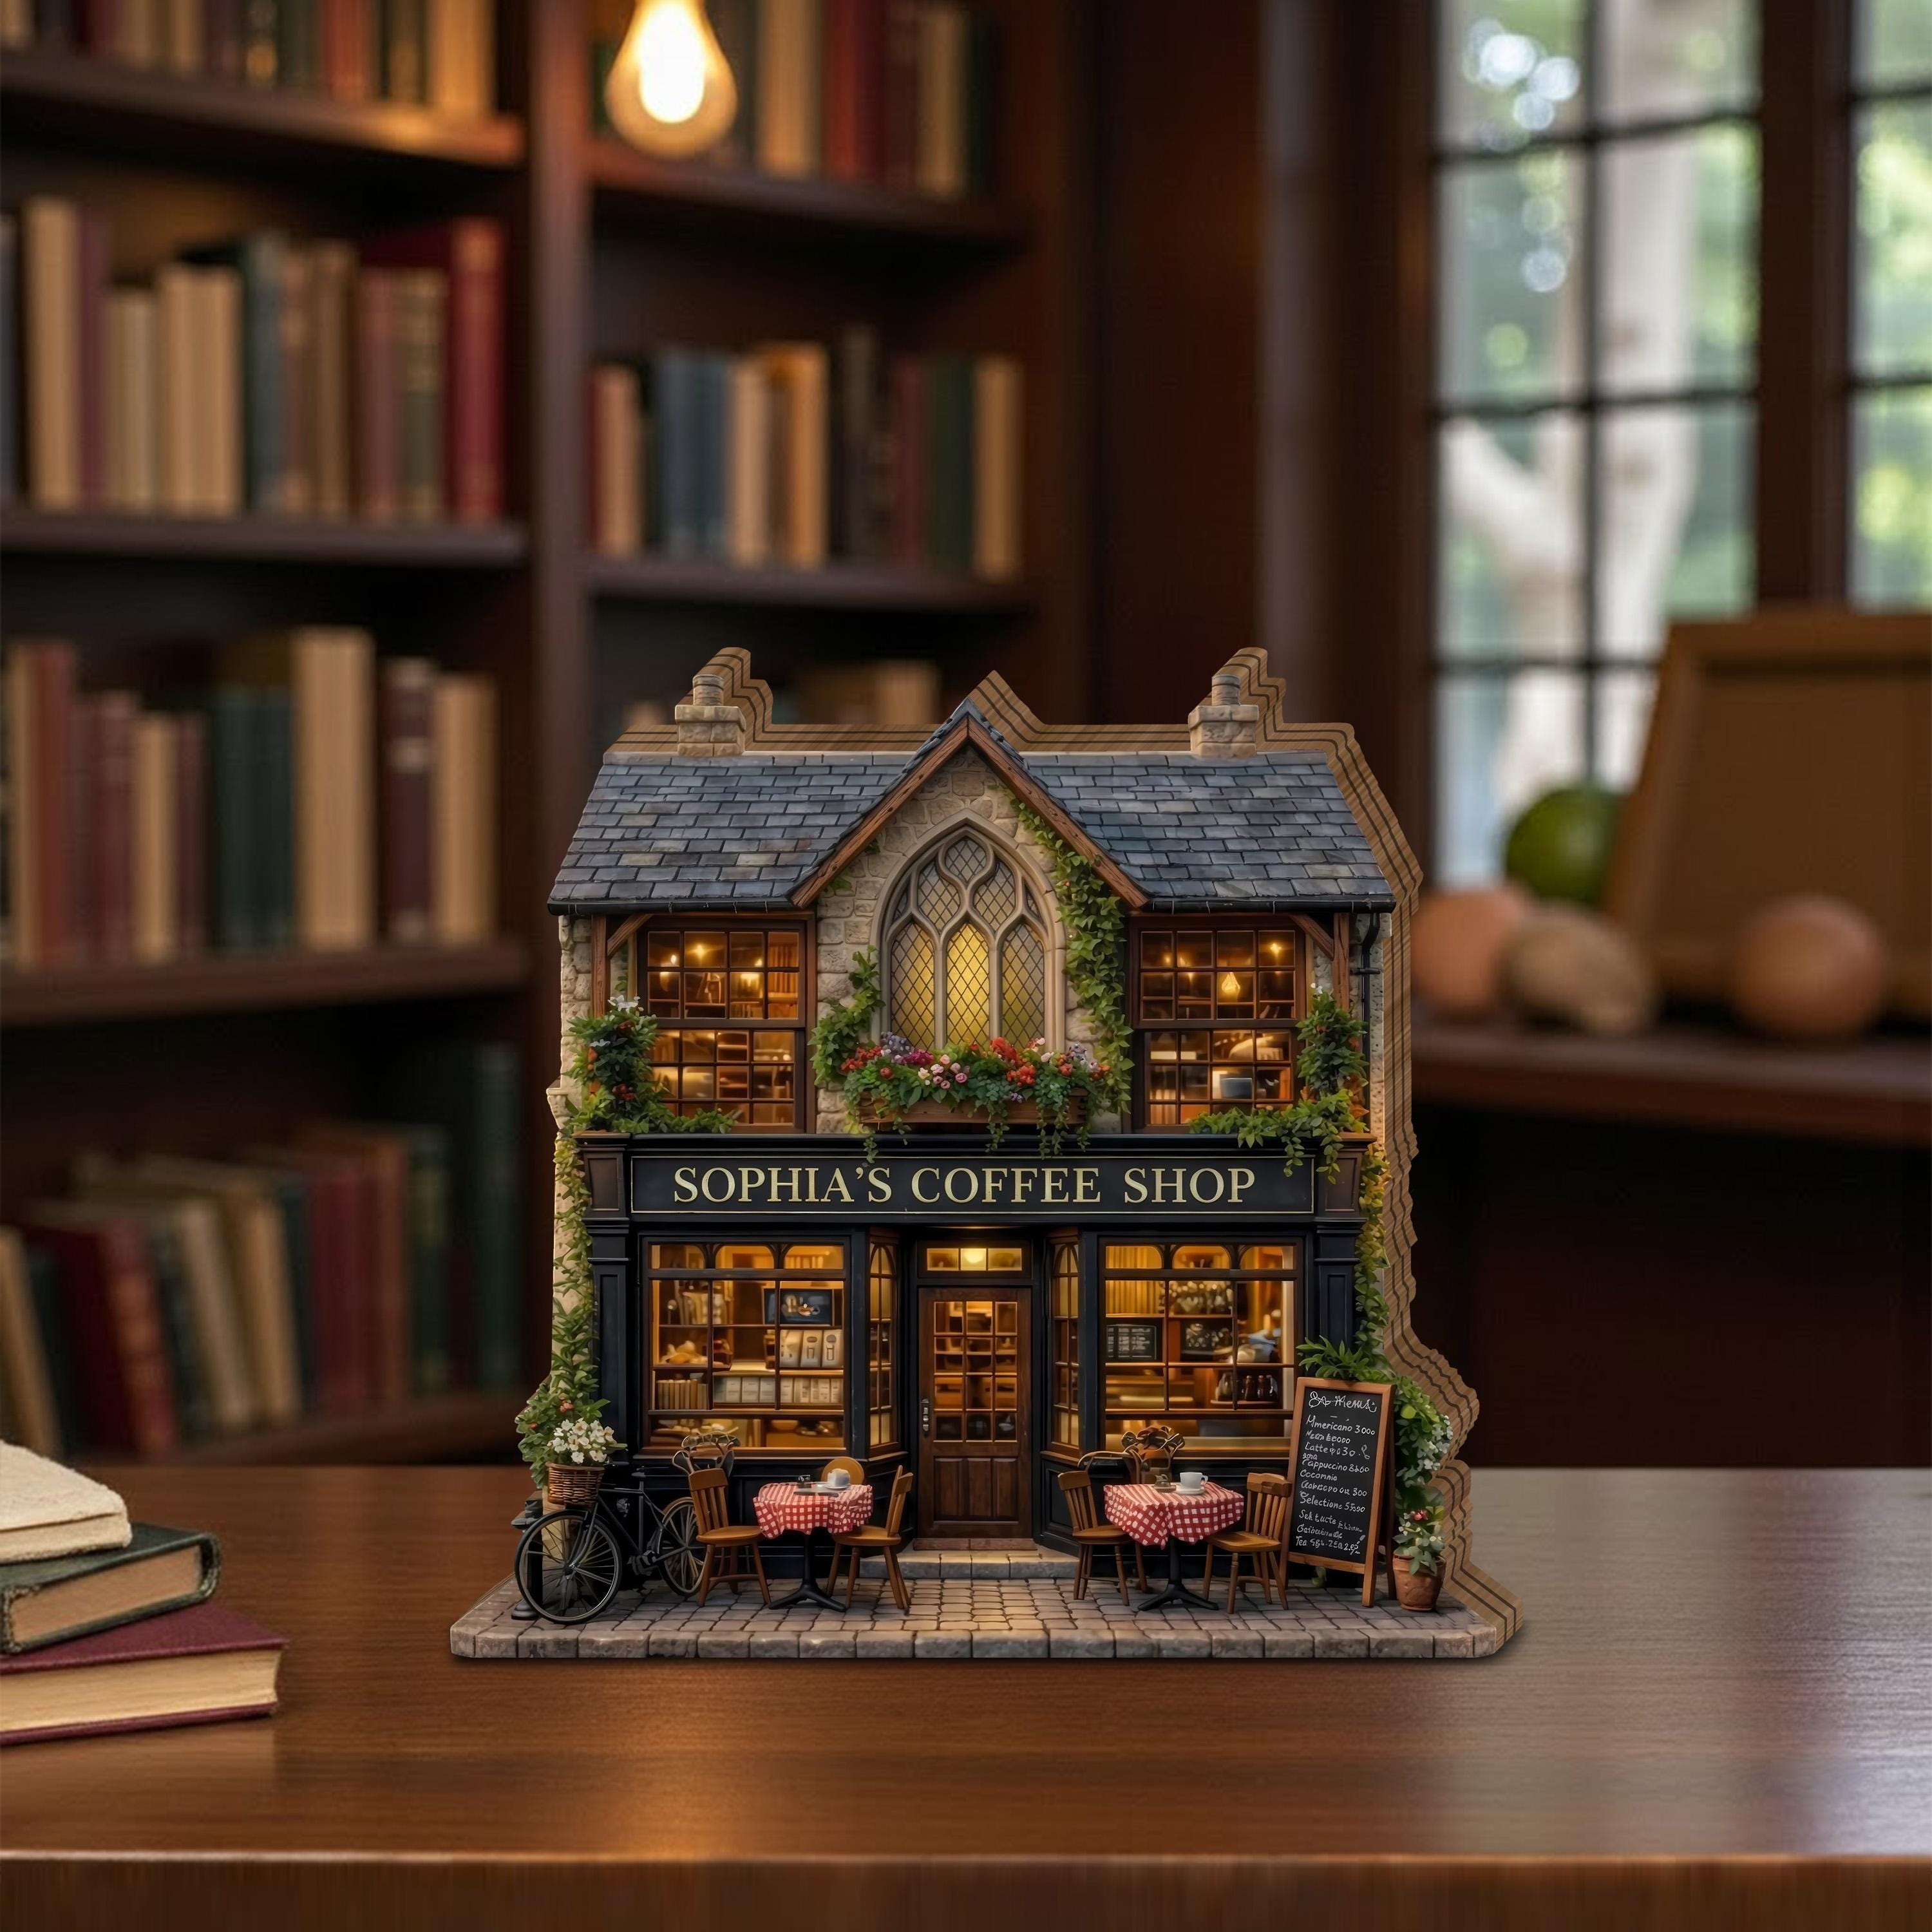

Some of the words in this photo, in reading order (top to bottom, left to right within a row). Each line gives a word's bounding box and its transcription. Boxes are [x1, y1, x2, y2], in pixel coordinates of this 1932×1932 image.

[675, 1168, 891, 1202] SOPHIA'S
[912, 1168, 1100, 1202] COFFEE
[1125, 1168, 1255, 1202] SHOP
[1302, 1459, 1348, 1471] Cappuccino
[1352, 1488, 1367, 1497] 300
[1296, 1536, 1307, 1546] Tea
